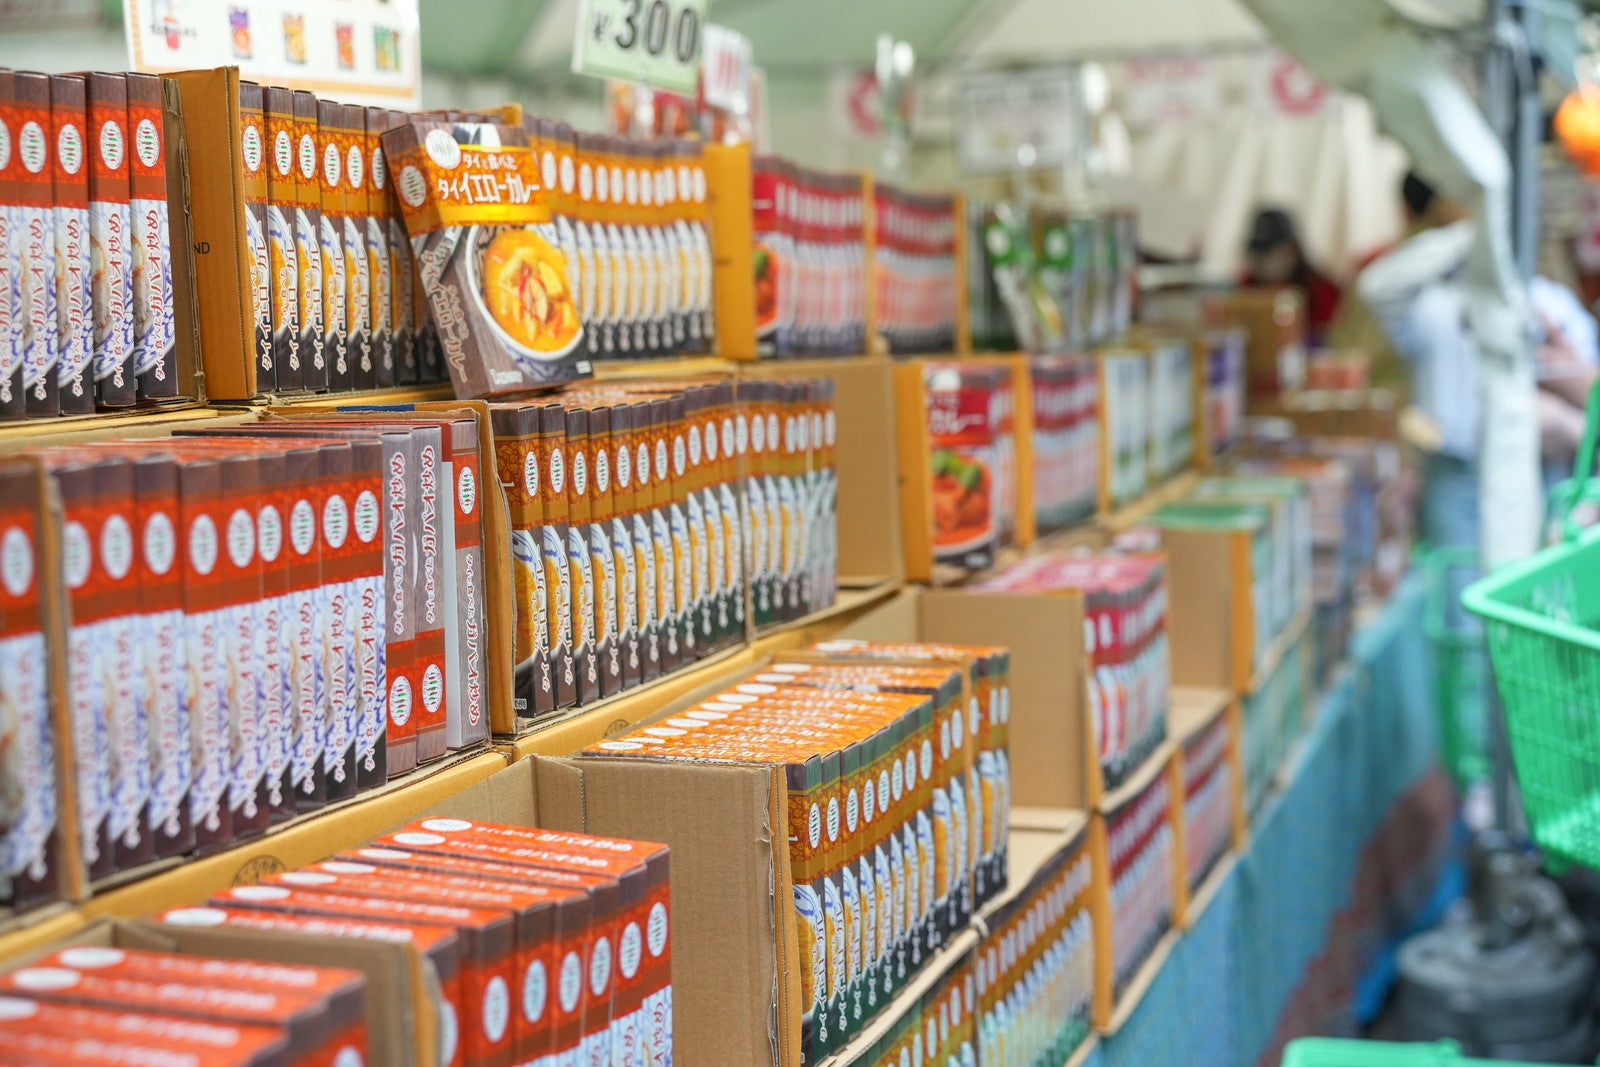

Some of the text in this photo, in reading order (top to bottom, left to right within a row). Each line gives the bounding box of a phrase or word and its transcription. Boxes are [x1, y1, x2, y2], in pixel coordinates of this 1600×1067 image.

[438, 172, 540, 204] タイイエローカレー
[108, 213, 125, 388] タイで食べたガパオ炒め
[146, 210, 165, 381] タイで食べたガパオ炒め
[389, 452, 406, 635] タイで食べたガパオ炒め
[421, 445, 437, 624] タイで食べたガパオ炒め
[330, 594, 347, 783] タイで食べたガパオ炒め
[362, 587, 378, 771] タイで食べたガパオ炒め
[465, 553, 481, 726] タイで食べたガパオ炒め
